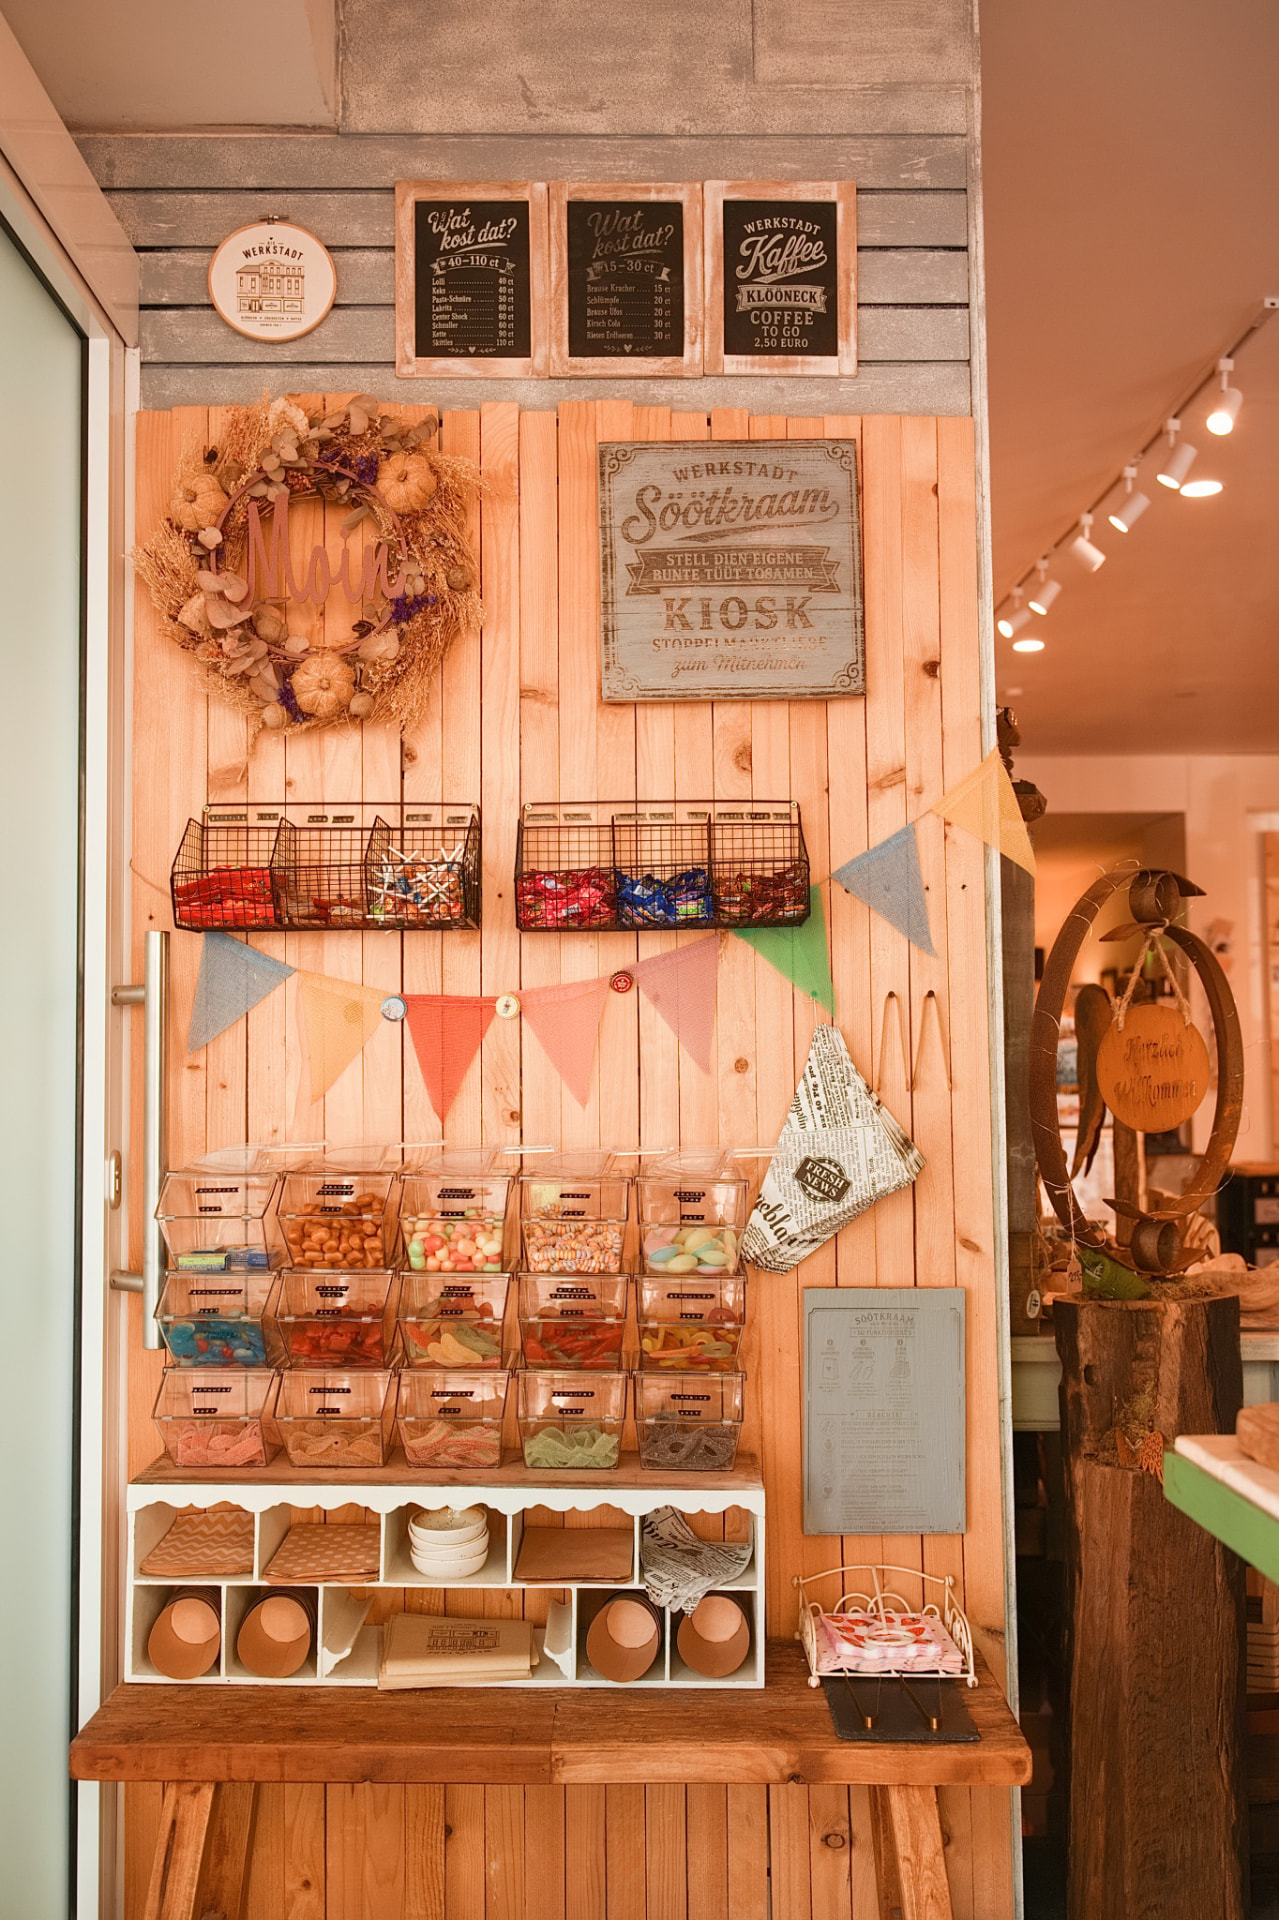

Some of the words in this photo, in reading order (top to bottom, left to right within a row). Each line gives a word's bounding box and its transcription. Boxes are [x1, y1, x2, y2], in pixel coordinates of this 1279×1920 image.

[427, 208, 471, 234] Wat
[587, 210, 644, 237] Wat
[744, 217, 821, 235] WERKSTADT
[440, 225, 476, 251] kost
[477, 217, 517, 242] dat?
[592, 233, 630, 259] kost
[632, 224, 674, 249] dat?
[242, 245, 304, 261] WERKSTADT
[736, 233, 826, 279] Kaffee
[489, 259, 499, 268] ct
[644, 264, 655, 273] ct
[747, 288, 818, 303] KLÖÖNECK
[750, 311, 814, 325] COFFEE
[762, 326, 779, 337] TO
[782, 326, 800, 337] GO
[754, 338, 778, 348] 2,50
[780, 339, 809, 348] EURO
[672, 461, 798, 482] WERKSTADT
[621, 485, 836, 544] Söötkraam
[246, 493, 407, 605] Moin
[666, 553, 709, 566] STELL
[714, 552, 748, 565] DIEN
[753, 552, 804, 565] EIGENE
[653, 569, 700, 582] BUNTE
[704, 567, 741, 581] TÜÜT
[748, 567, 814, 580] TOSAMEN
[663, 596, 815, 631] KIOSK
[670, 659, 709, 679] zum
[803, 1171, 839, 1199] NEWS
[805, 1161, 845, 1189] FRESH
[854, 1312, 915, 1326] SÖÖTKRAAM
